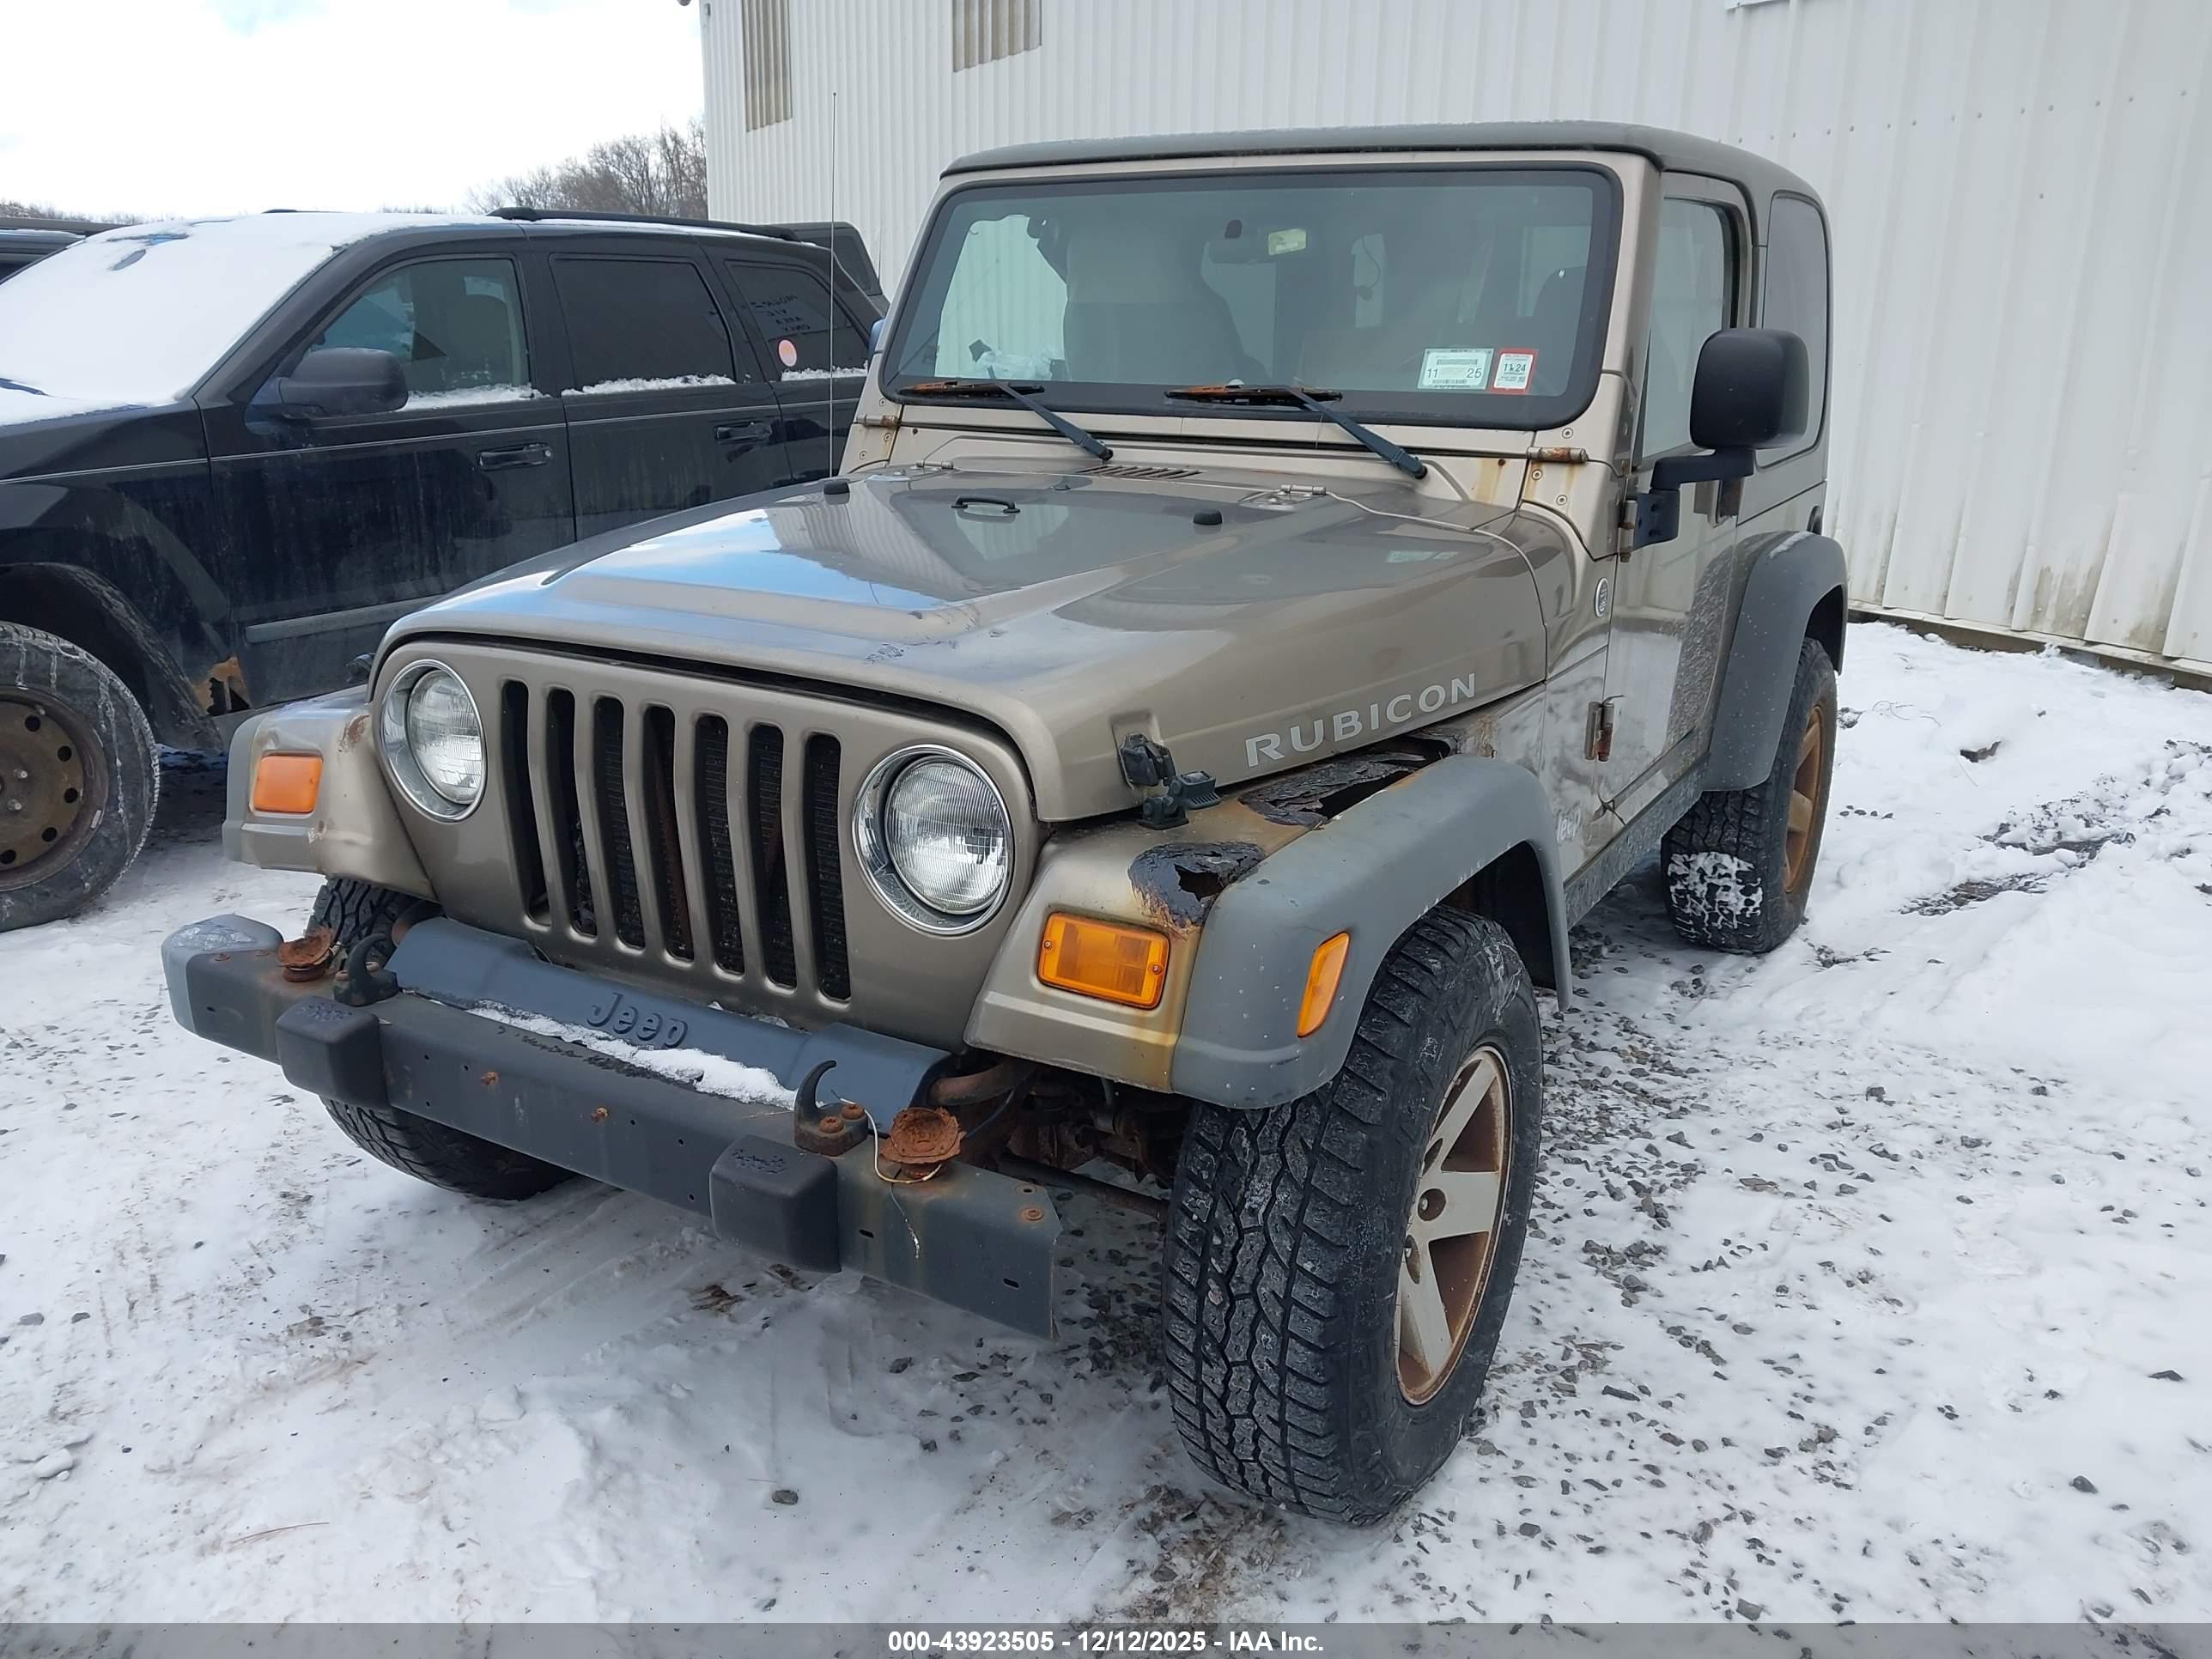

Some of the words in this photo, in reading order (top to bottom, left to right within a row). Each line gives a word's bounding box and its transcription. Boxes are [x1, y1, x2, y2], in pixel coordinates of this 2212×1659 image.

[1427, 368, 1438, 379] 11
[1466, 368, 1482, 379] 25
[1245, 672, 1476, 768] RUBICON
[586, 992, 689, 1048] Jeep
